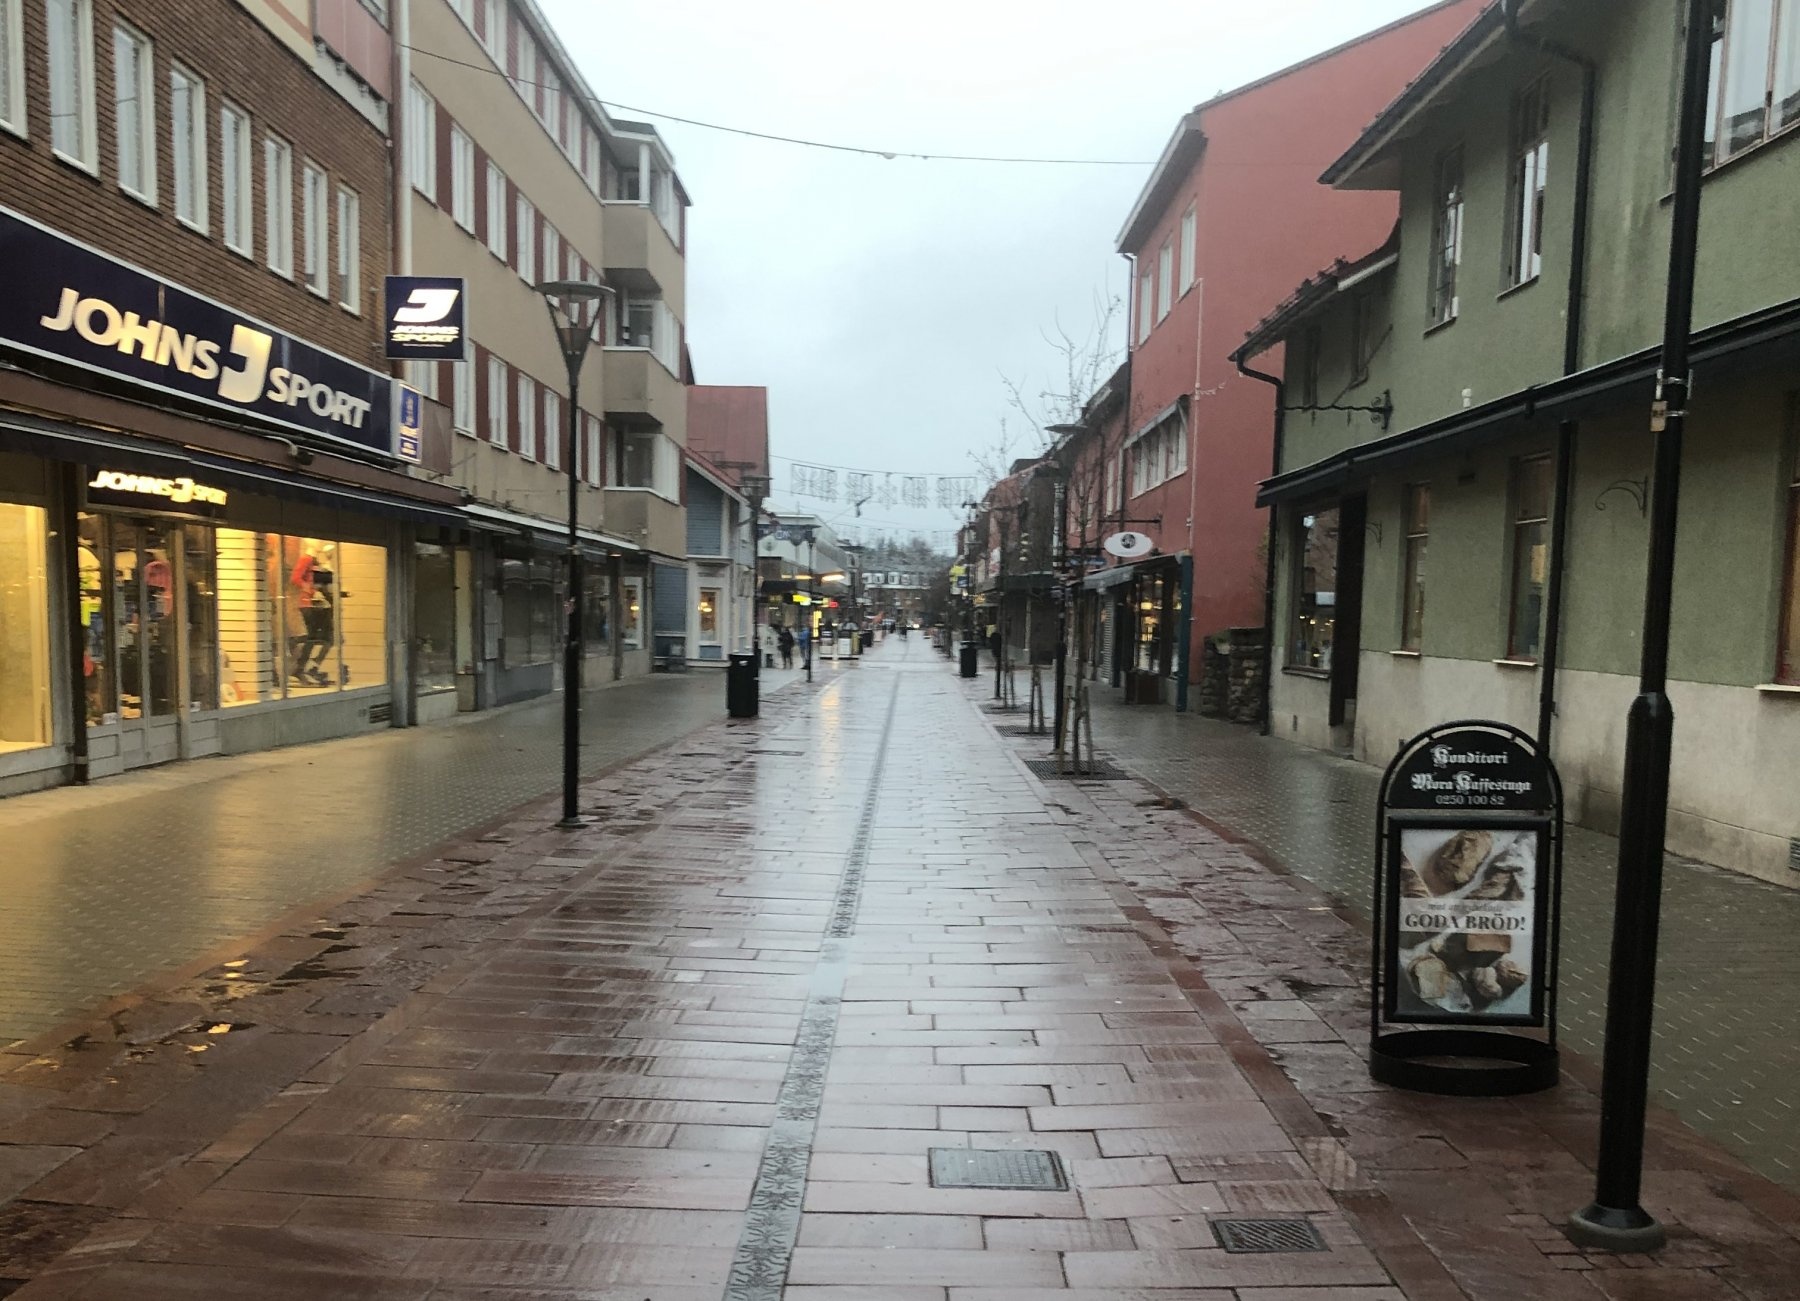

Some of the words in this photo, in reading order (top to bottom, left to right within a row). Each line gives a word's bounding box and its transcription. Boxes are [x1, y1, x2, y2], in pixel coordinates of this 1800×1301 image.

[40, 287, 221, 380] JOHNS
[266, 367, 371, 428] SPORT
[88, 470, 175, 496] JOHNS
[192, 484, 227, 505] SPORT
[1430, 744, 1508, 768] Konditori
[1411, 772, 1454, 791] Mora
[1453, 771, 1531, 795] Kaffestuga
[1435, 794, 1464, 805] 0250
[1468, 795, 1488, 805] 100
[1405, 913, 1459, 929] GODA
[1465, 913, 1527, 931] BRÖD!
